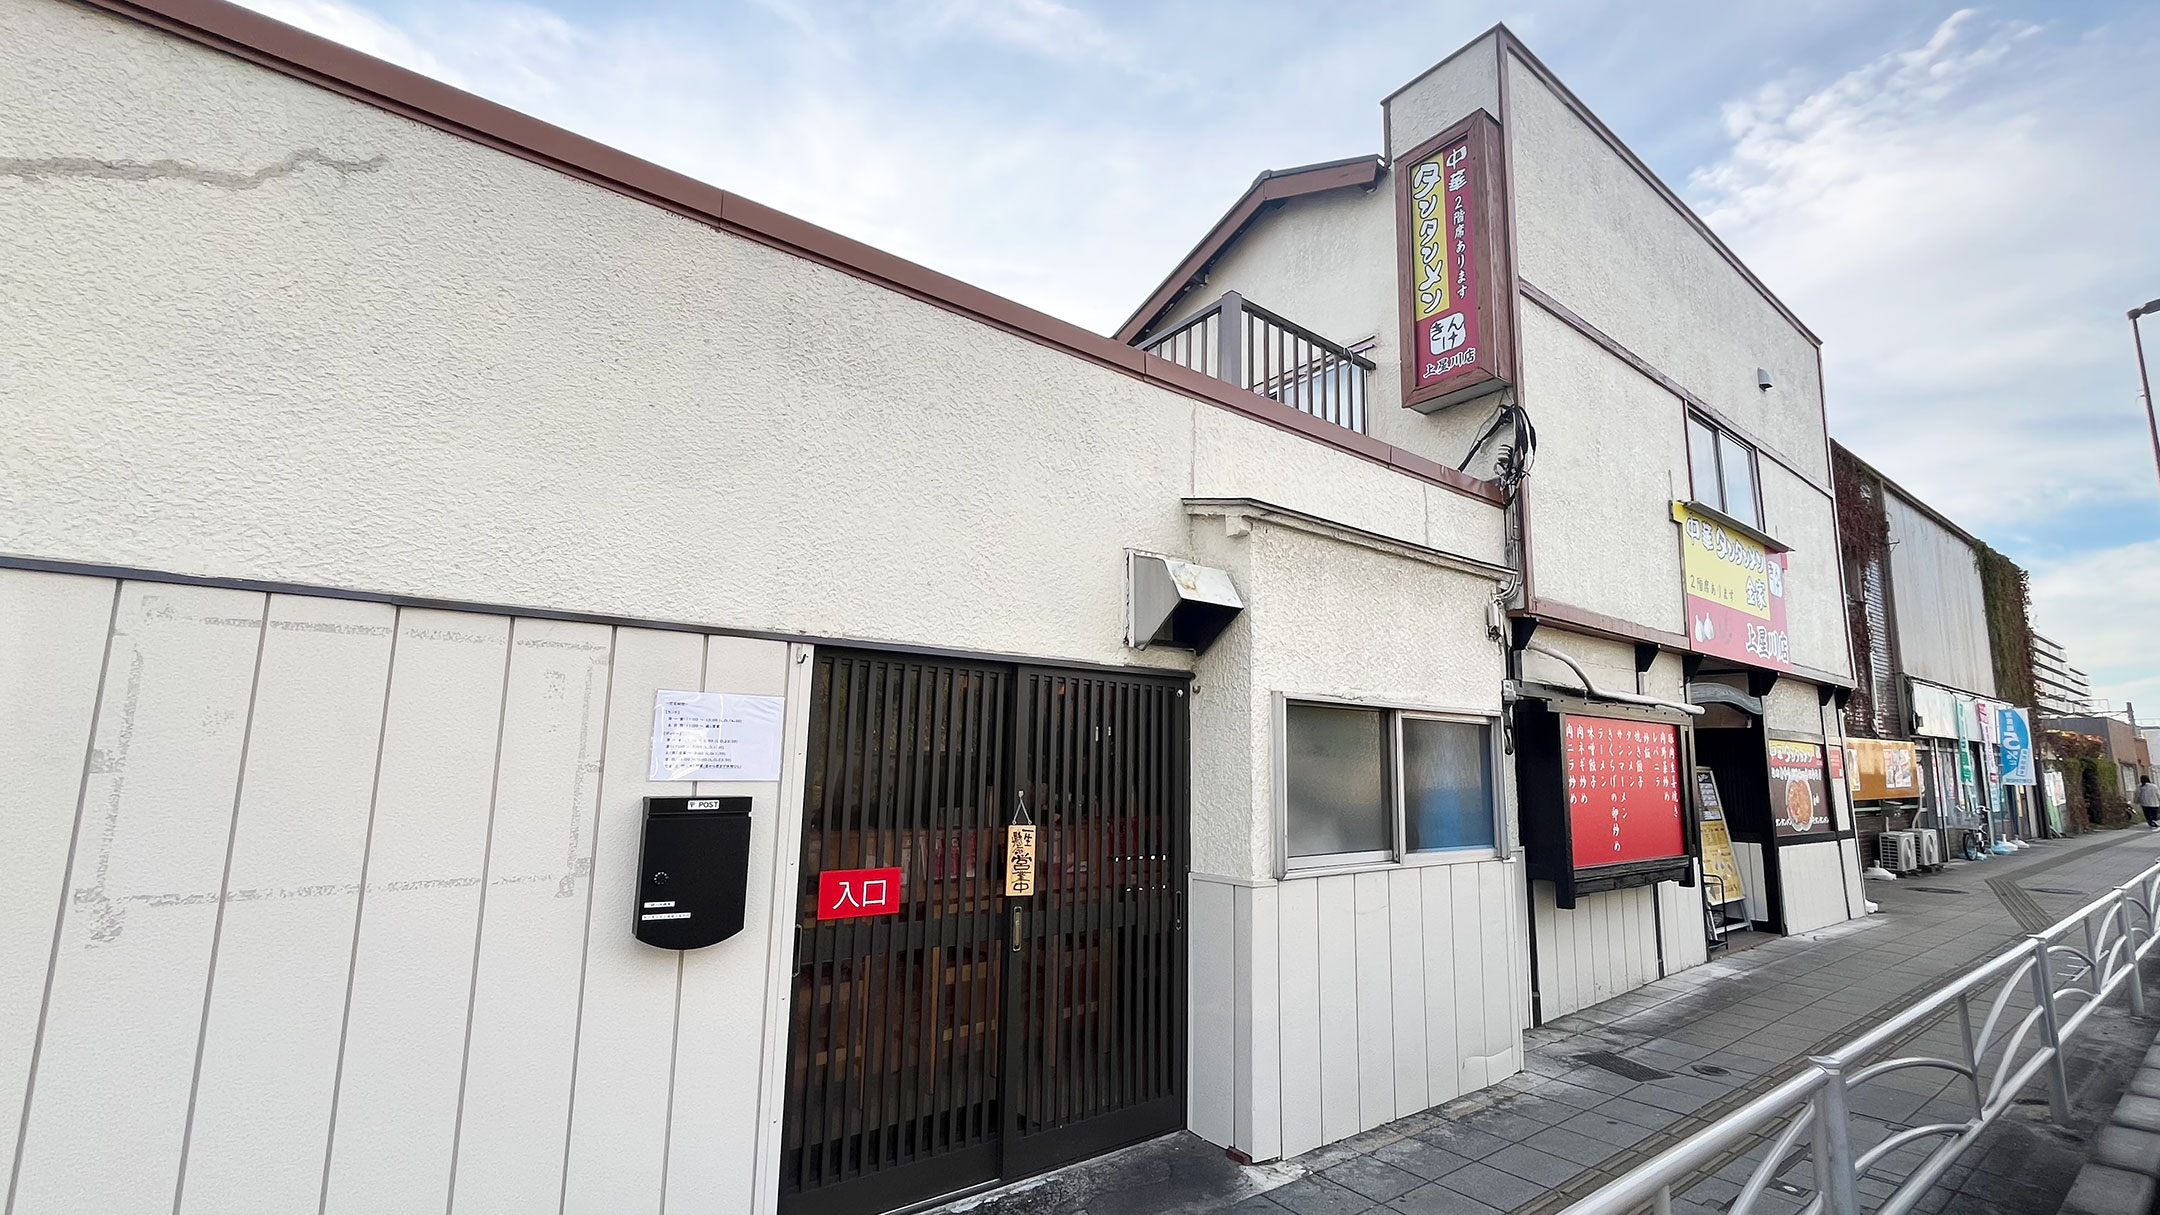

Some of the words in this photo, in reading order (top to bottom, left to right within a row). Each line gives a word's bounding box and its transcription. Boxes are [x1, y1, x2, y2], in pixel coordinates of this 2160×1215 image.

[1446, 145, 1468, 192] 中華
[1413, 161, 1442, 314] タンタンメン
[1423, 348, 1476, 378] 上星川店
[1745, 575, 1768, 611] 金家
[1565, 723, 1578, 804] 肉ニラ炒め
[1597, 727, 1607, 788] ラーメン
[1616, 729, 1628, 819] サンマーメン
[1625, 730, 1635, 788] タンメン
[832, 880, 887, 910] 入口
[1011, 853, 1032, 893] 営業中
